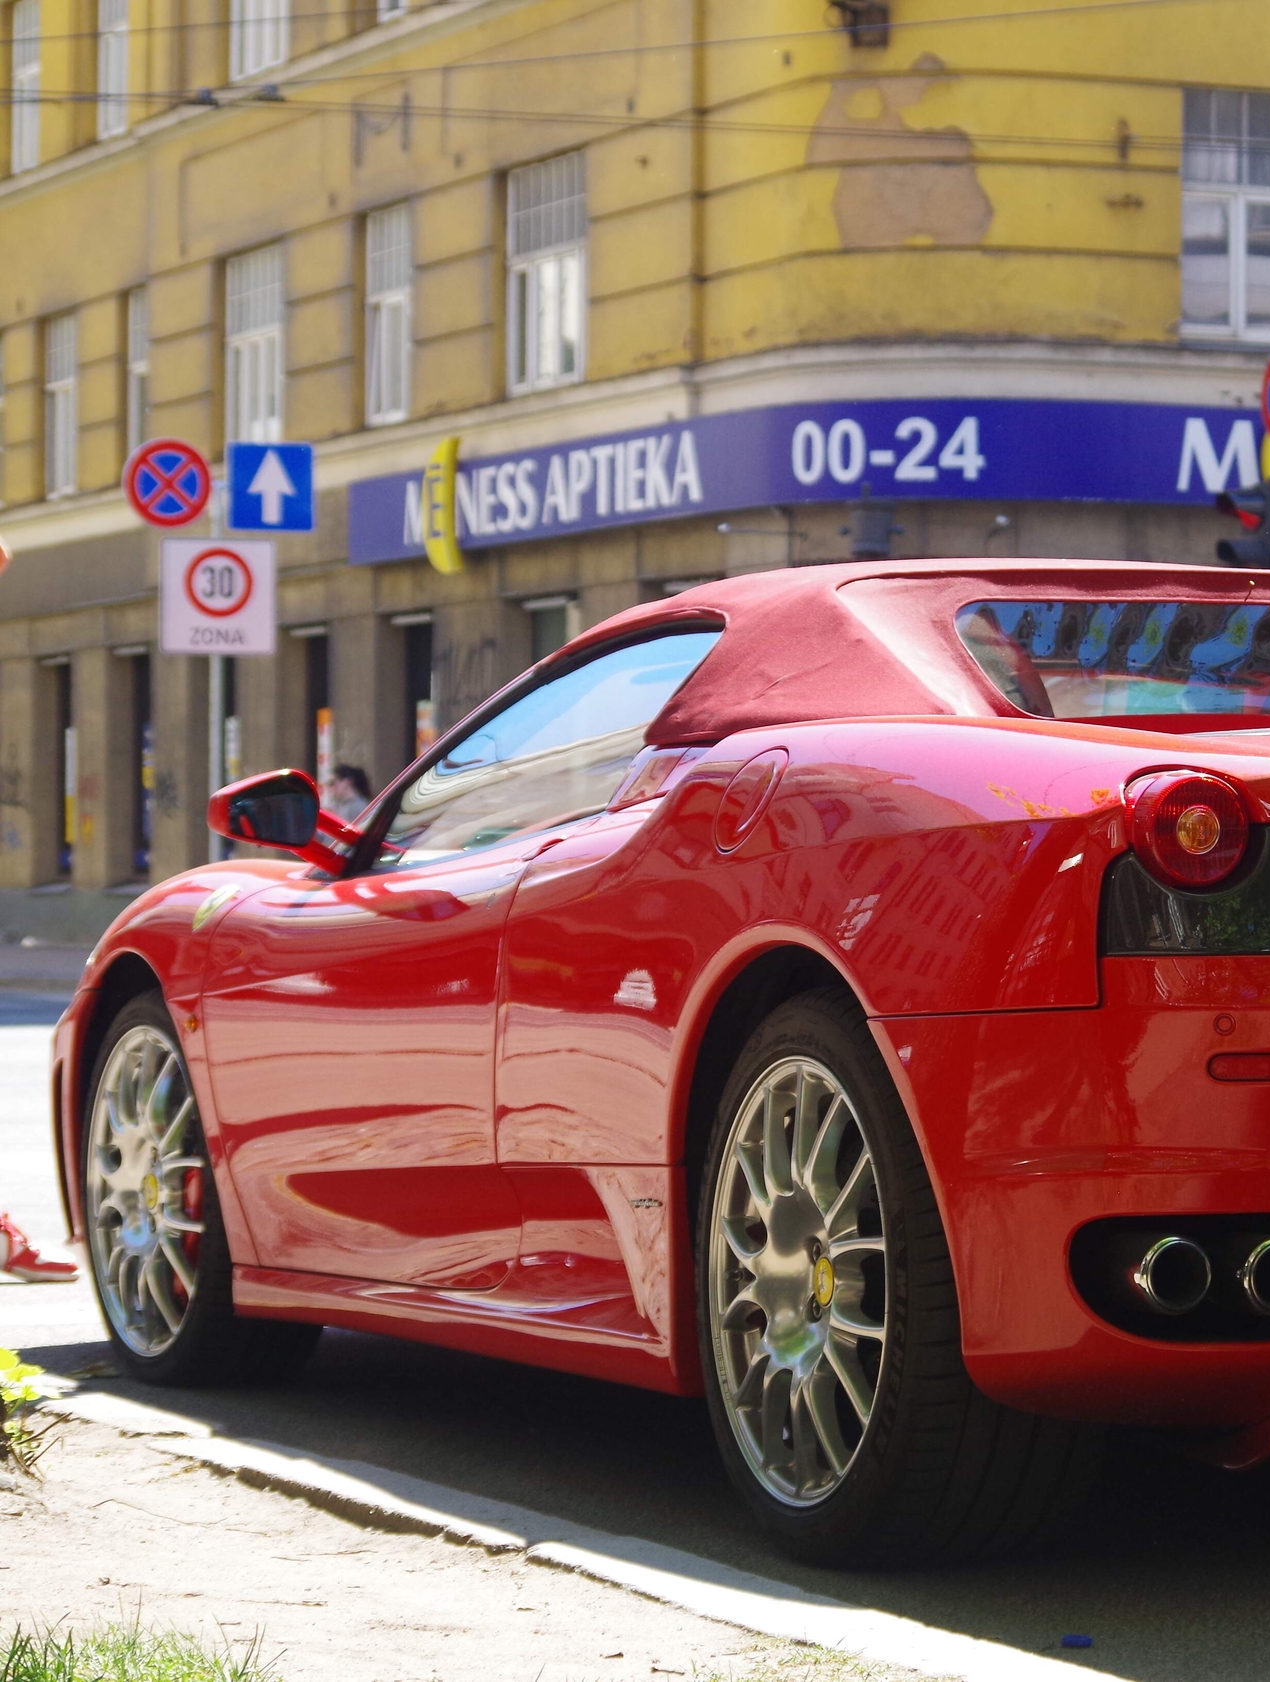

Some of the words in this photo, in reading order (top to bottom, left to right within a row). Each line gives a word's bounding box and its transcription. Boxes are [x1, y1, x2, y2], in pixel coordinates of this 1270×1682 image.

[791, 416, 985, 485] 00-24
[543, 431, 703, 524] APTIEKA
[200, 566, 233, 598] 30
[189, 626, 245, 645] ZONA
